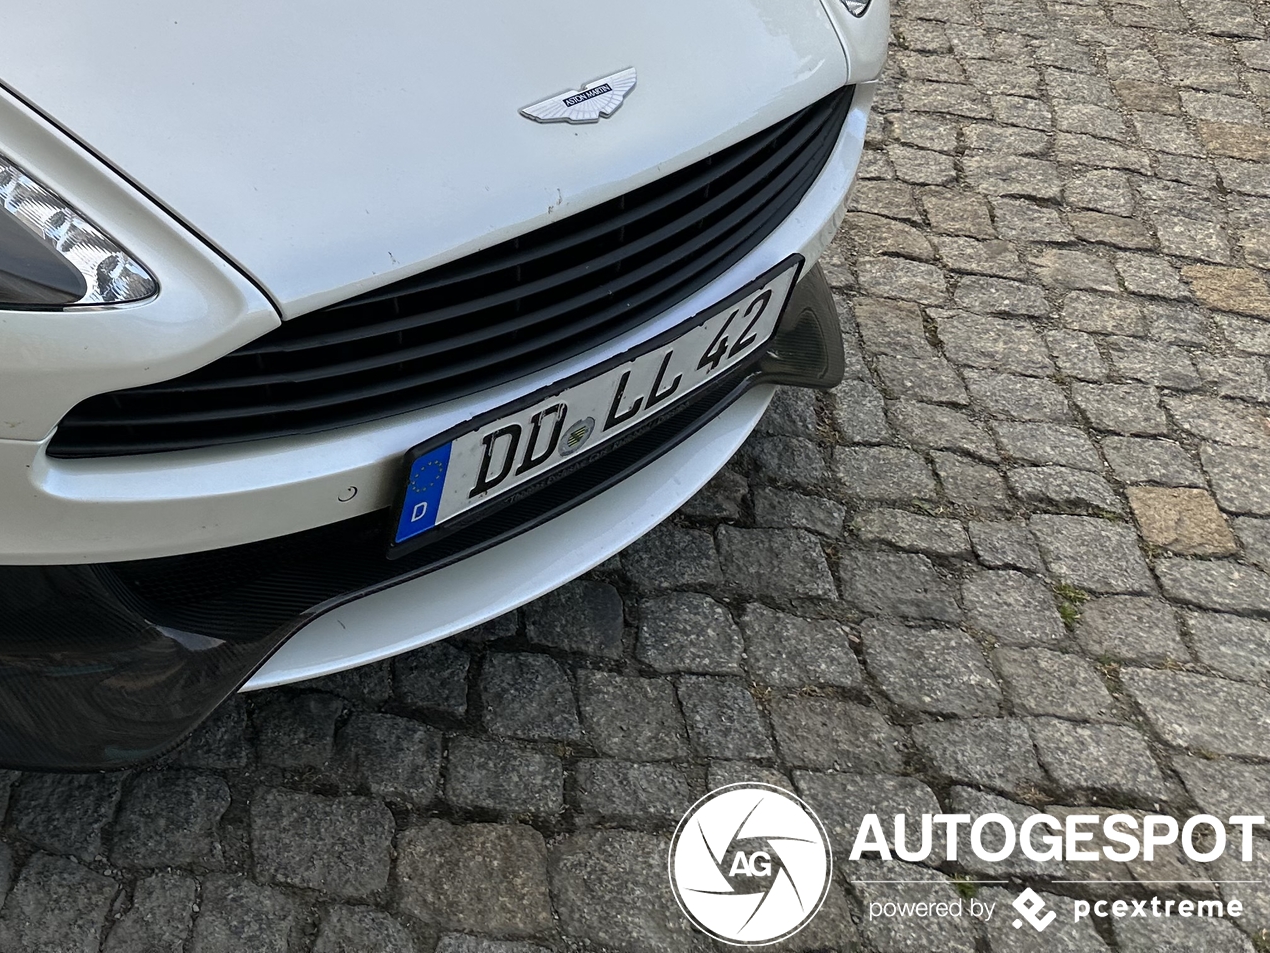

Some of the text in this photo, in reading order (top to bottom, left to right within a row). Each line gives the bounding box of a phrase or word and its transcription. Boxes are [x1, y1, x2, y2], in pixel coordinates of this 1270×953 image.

[565, 84, 611, 106] ASTON MARTIN
[468, 402, 568, 499] DD
[603, 350, 684, 432] LL
[696, 288, 773, 373] 42
[410, 501, 428, 523] D
